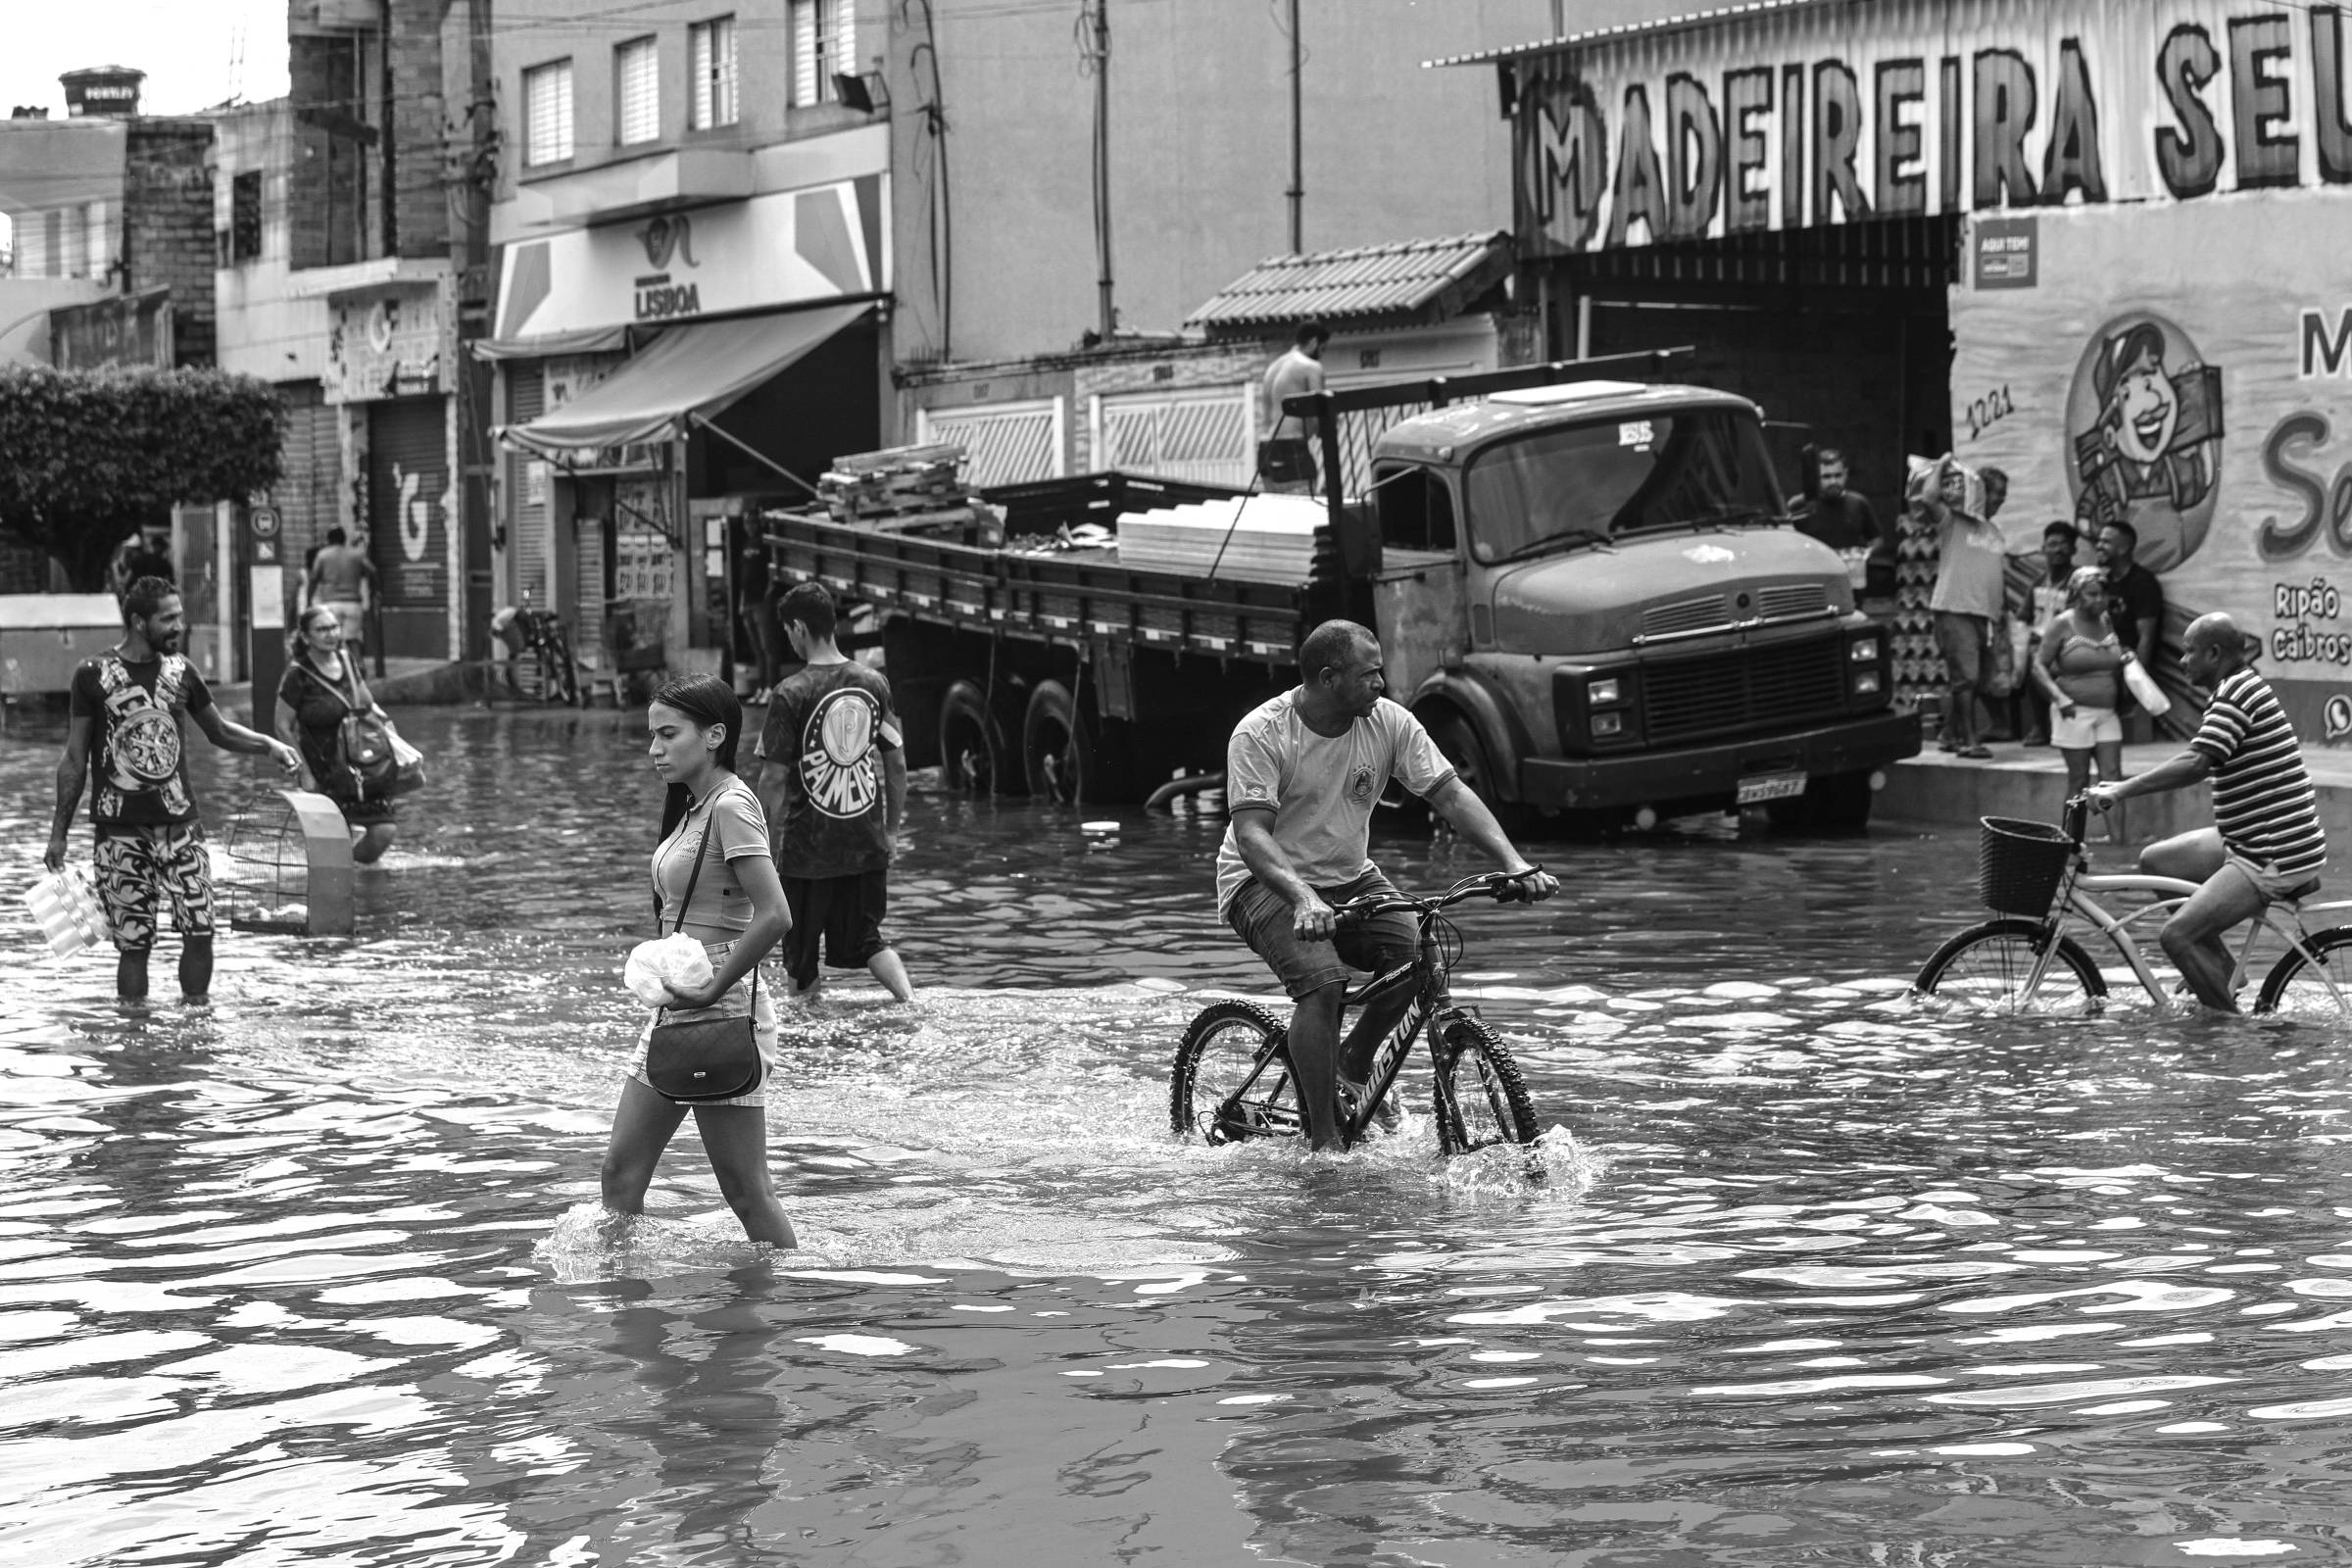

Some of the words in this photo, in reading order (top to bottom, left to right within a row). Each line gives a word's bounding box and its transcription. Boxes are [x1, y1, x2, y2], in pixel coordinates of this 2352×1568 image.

[1519, 36, 2104, 253] MADEIREIRA
[1981, 237, 2005, 252] AQUI
[635, 282, 701, 318] LISBOA
[1965, 383, 2015, 441] 1221
[1356, 995, 1422, 1118] HOUSTON
